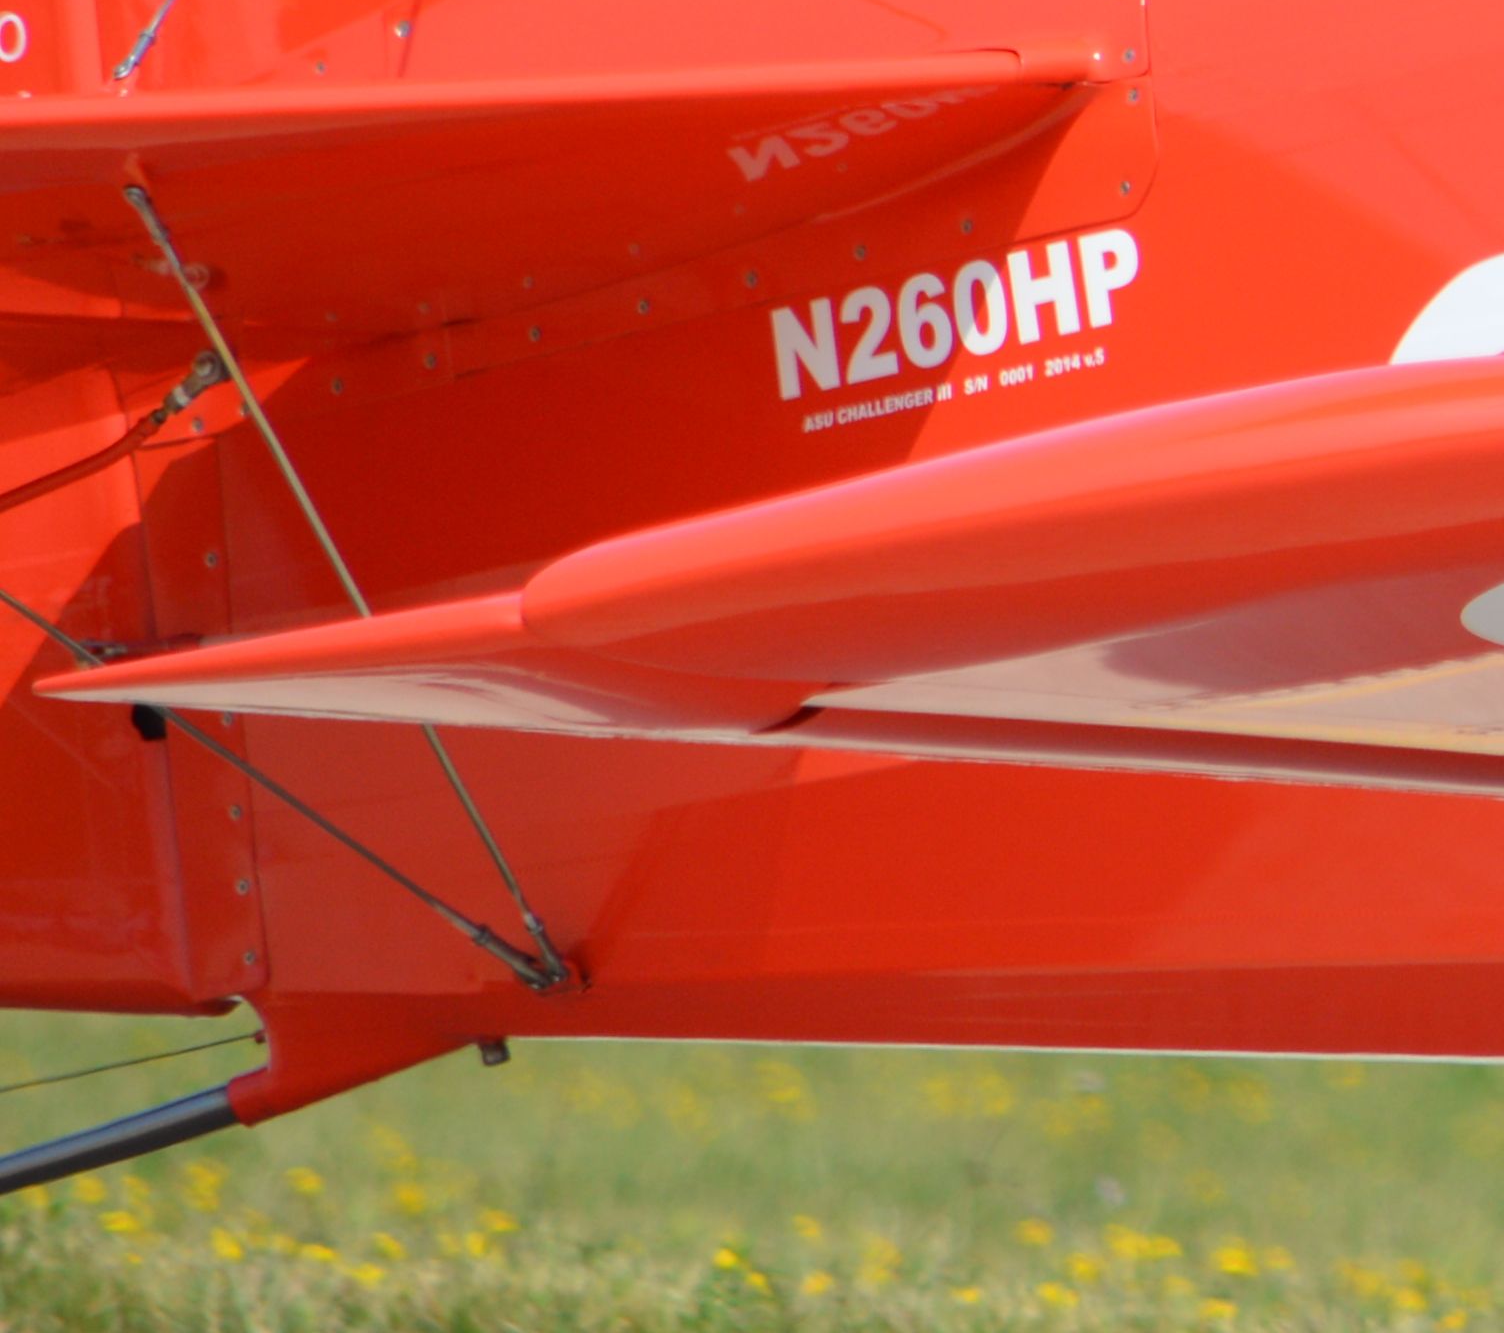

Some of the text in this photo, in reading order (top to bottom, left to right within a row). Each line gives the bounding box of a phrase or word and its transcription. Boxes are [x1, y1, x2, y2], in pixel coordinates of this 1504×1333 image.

[770, 228, 1139, 401] N260HP
[803, 414, 834, 433] ASU
[837, 389, 933, 426] CHALLENGER
[964, 376, 988, 395] S/N
[999, 364, 1033, 387] 0001
[1045, 354, 1081, 378] 2014
